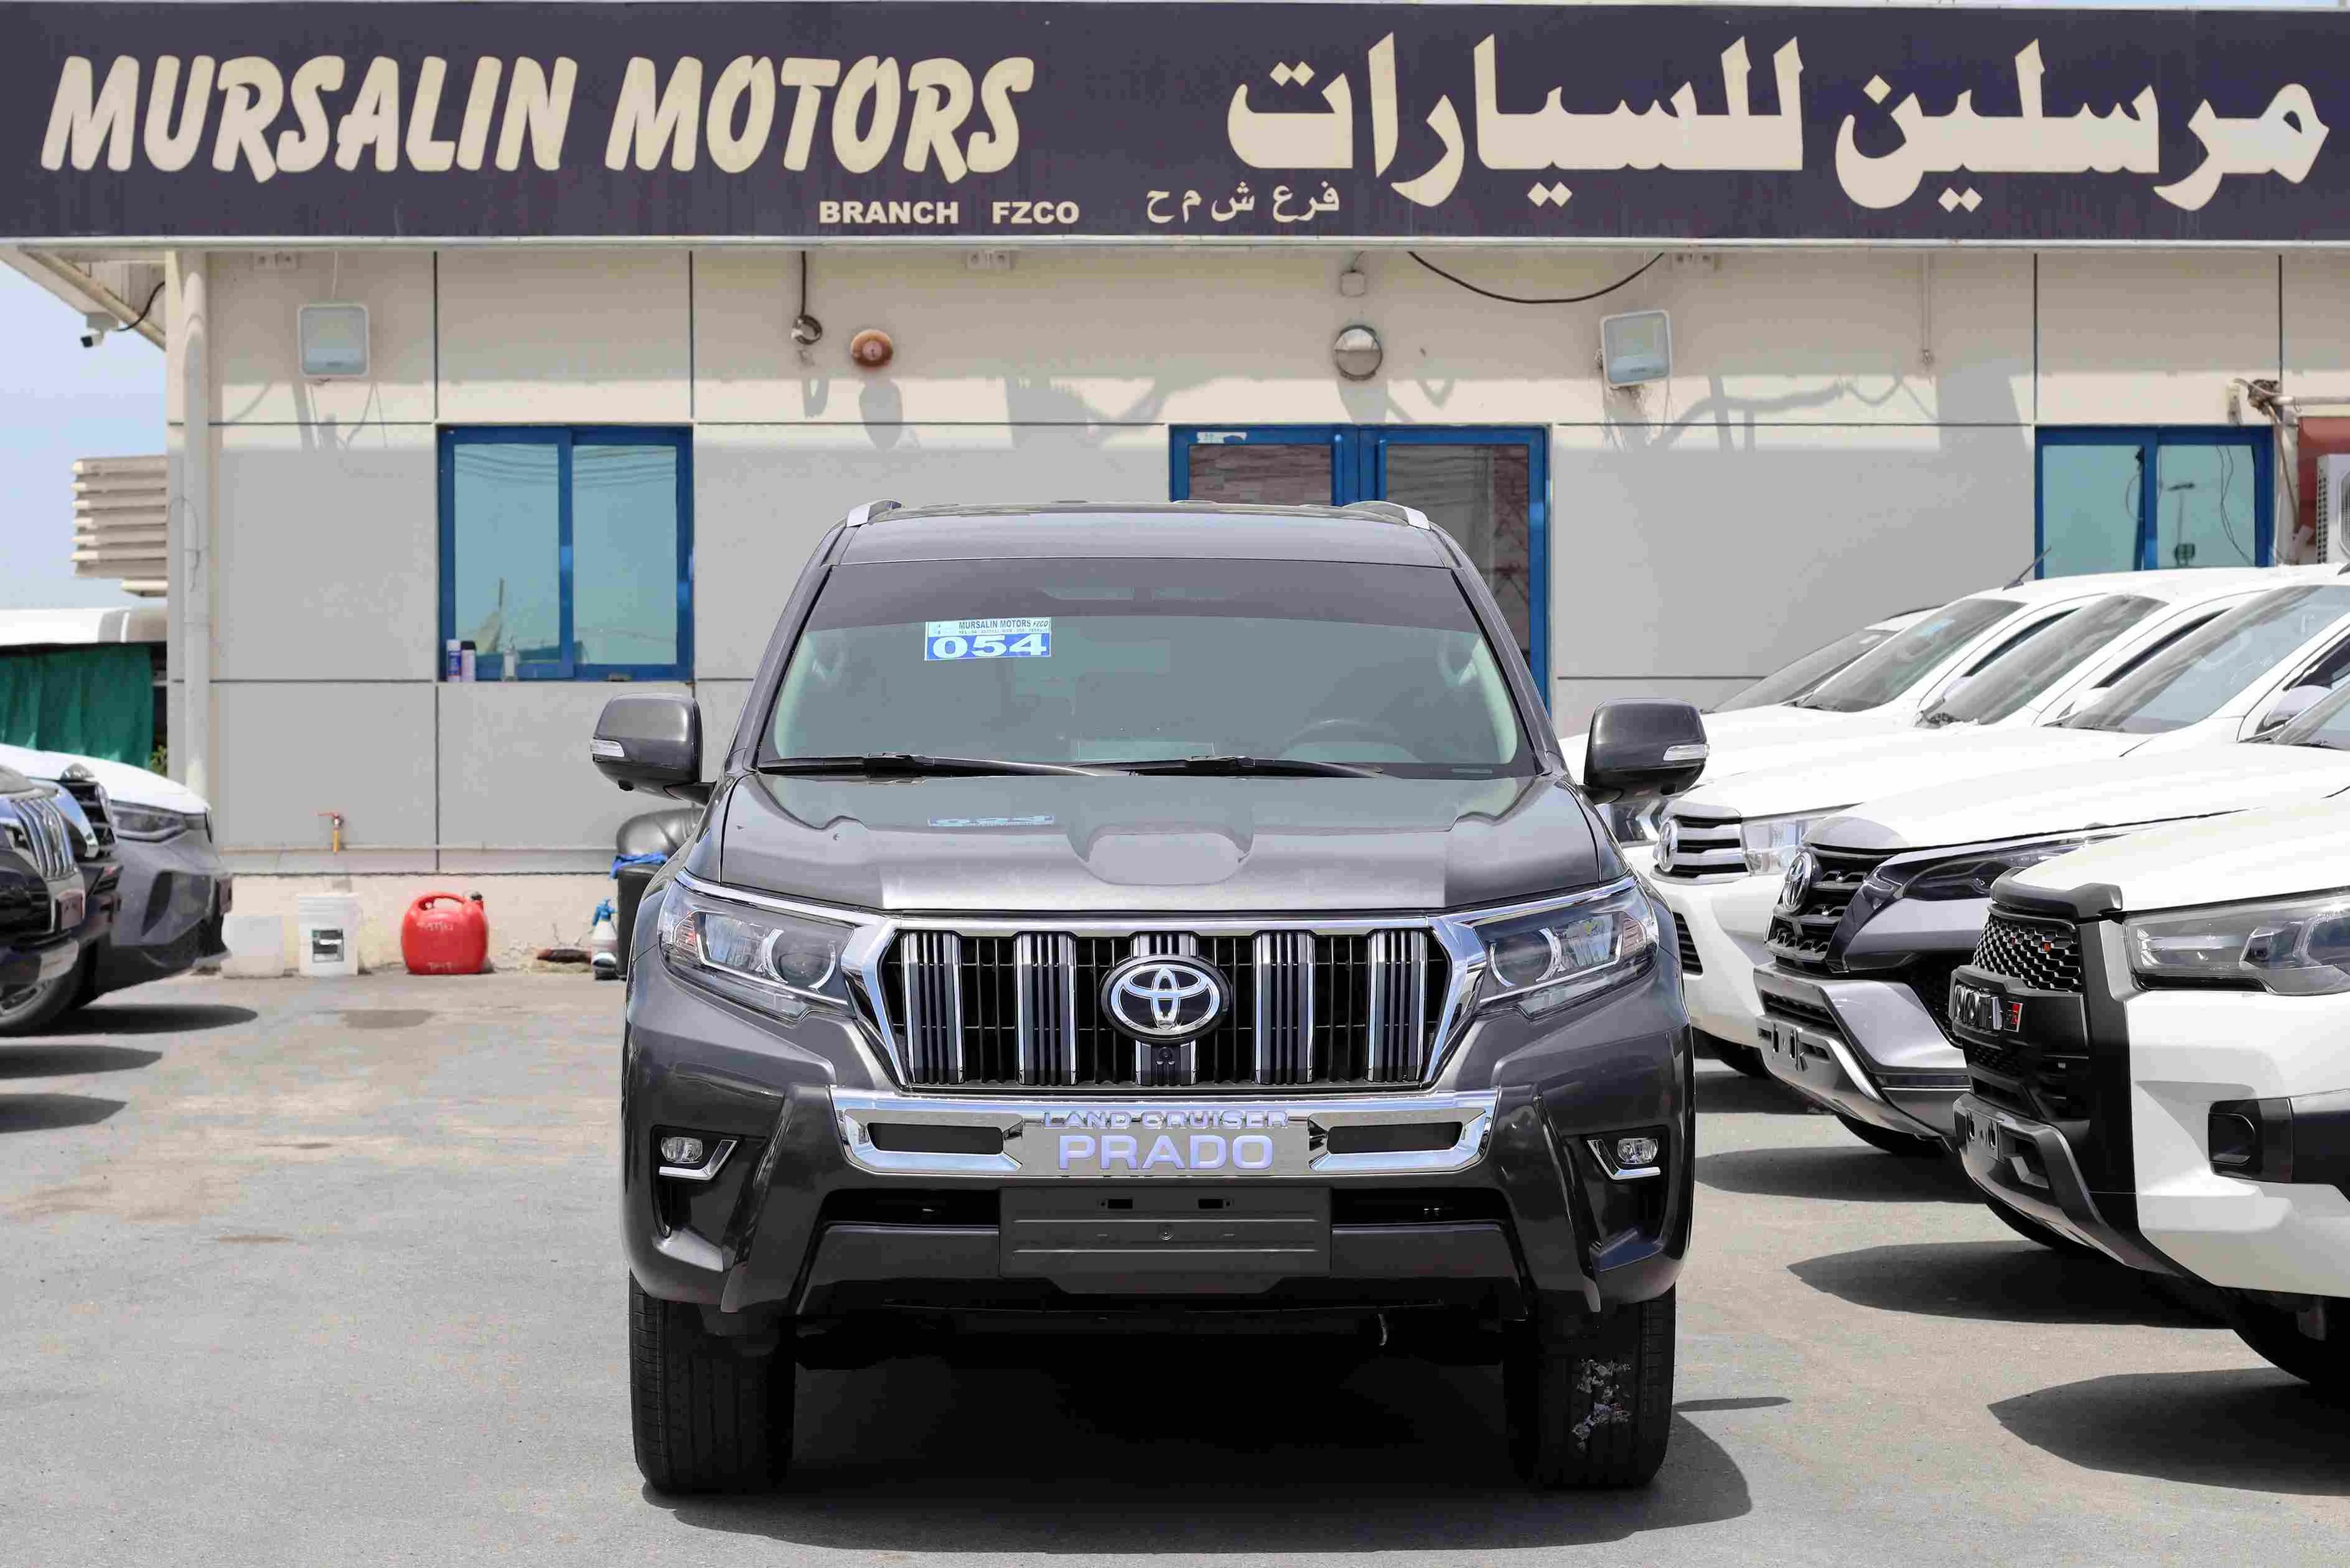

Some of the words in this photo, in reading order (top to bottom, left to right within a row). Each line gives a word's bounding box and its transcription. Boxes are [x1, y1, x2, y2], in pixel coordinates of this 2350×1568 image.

[42, 55, 577, 183] MURSALIN
[606, 55, 1034, 183] MOTORS
[1227, 32, 1803, 207] للسيارات
[1835, 39, 2329, 212] مرسلين
[820, 202, 958, 224] BRANCH
[993, 202, 1079, 224] FZCO
[1273, 181, 1339, 222] فرع
[959, 620, 998, 629] MURSALIN
[1000, 619, 1031, 628] MOTORS
[933, 633, 1047, 658] 054
[1043, 1111, 1131, 1129] LAND
[1141, 1110, 1290, 1129] CRUISER
[1057, 1134, 1273, 1170] PRADO
